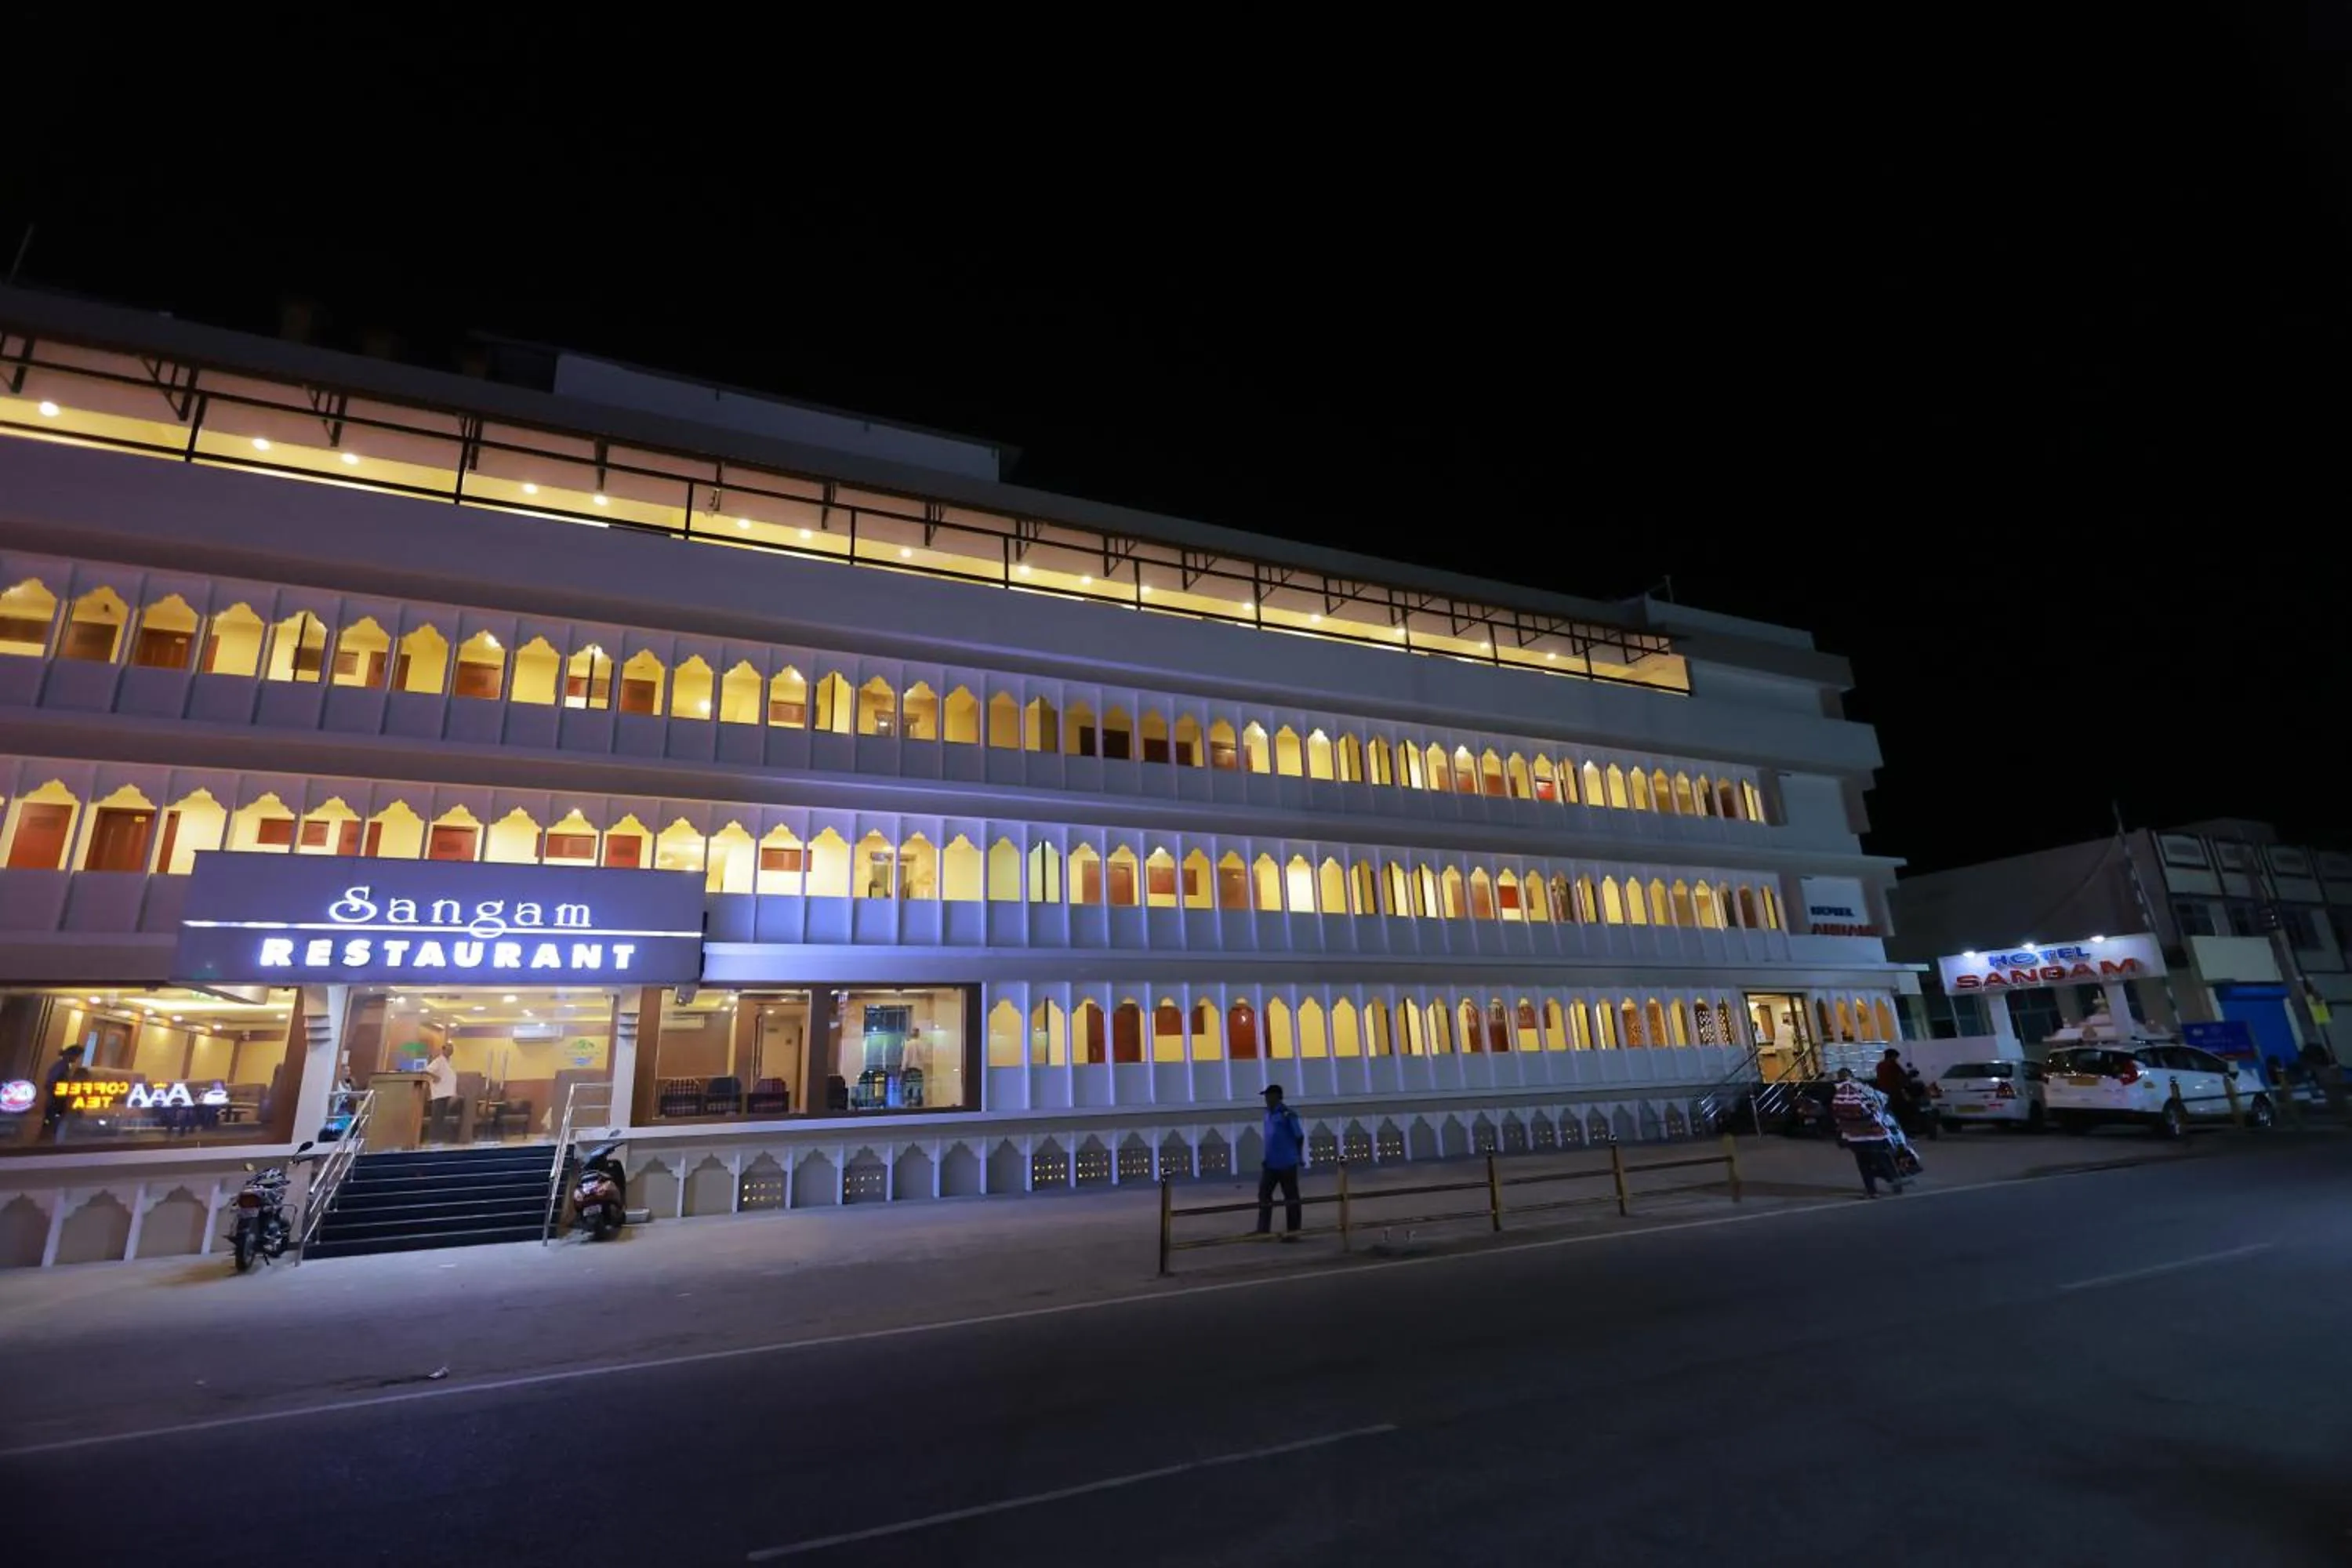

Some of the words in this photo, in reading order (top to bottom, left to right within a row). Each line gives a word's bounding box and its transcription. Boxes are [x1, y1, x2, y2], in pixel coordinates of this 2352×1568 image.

[328, 886, 591, 938] Sangam
[260, 938, 636, 970] RESTAURANT
[1988, 946, 2092, 967] HOTEL
[1956, 958, 2140, 989] SANGAM
